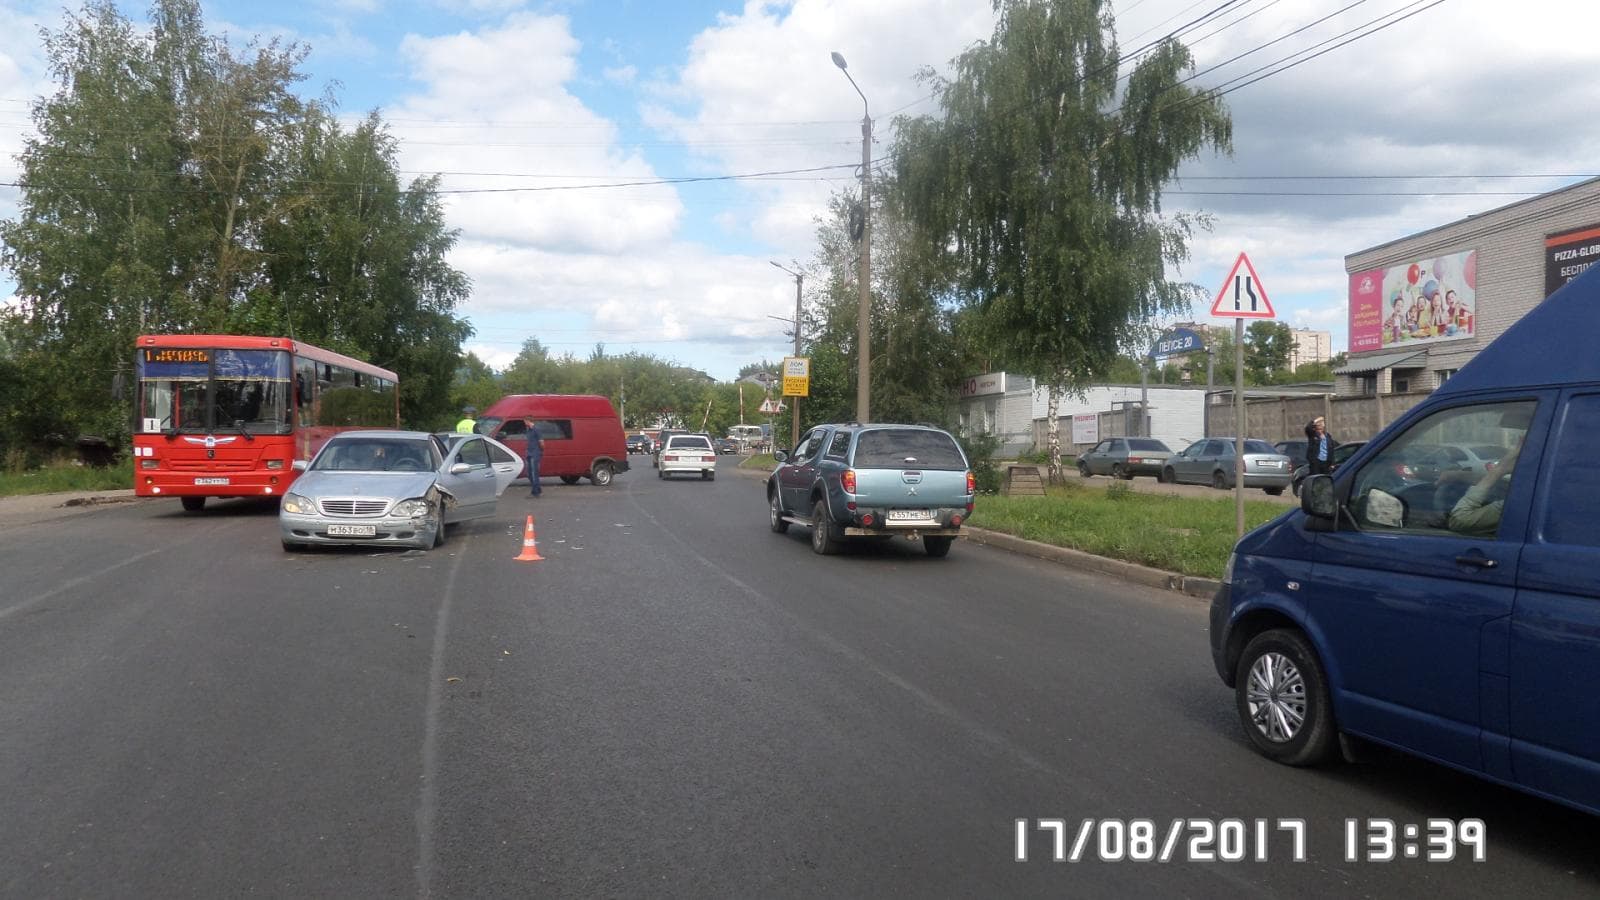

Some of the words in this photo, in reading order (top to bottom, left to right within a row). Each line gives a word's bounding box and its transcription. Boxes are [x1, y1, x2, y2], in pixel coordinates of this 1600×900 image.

[1554, 244, 1600, 262] PIZZA-GLOB
[1561, 262, 1593, 277] БЕСПЛ
[1184, 336, 1193, 348] 20
[959, 378, 977, 396] НО
